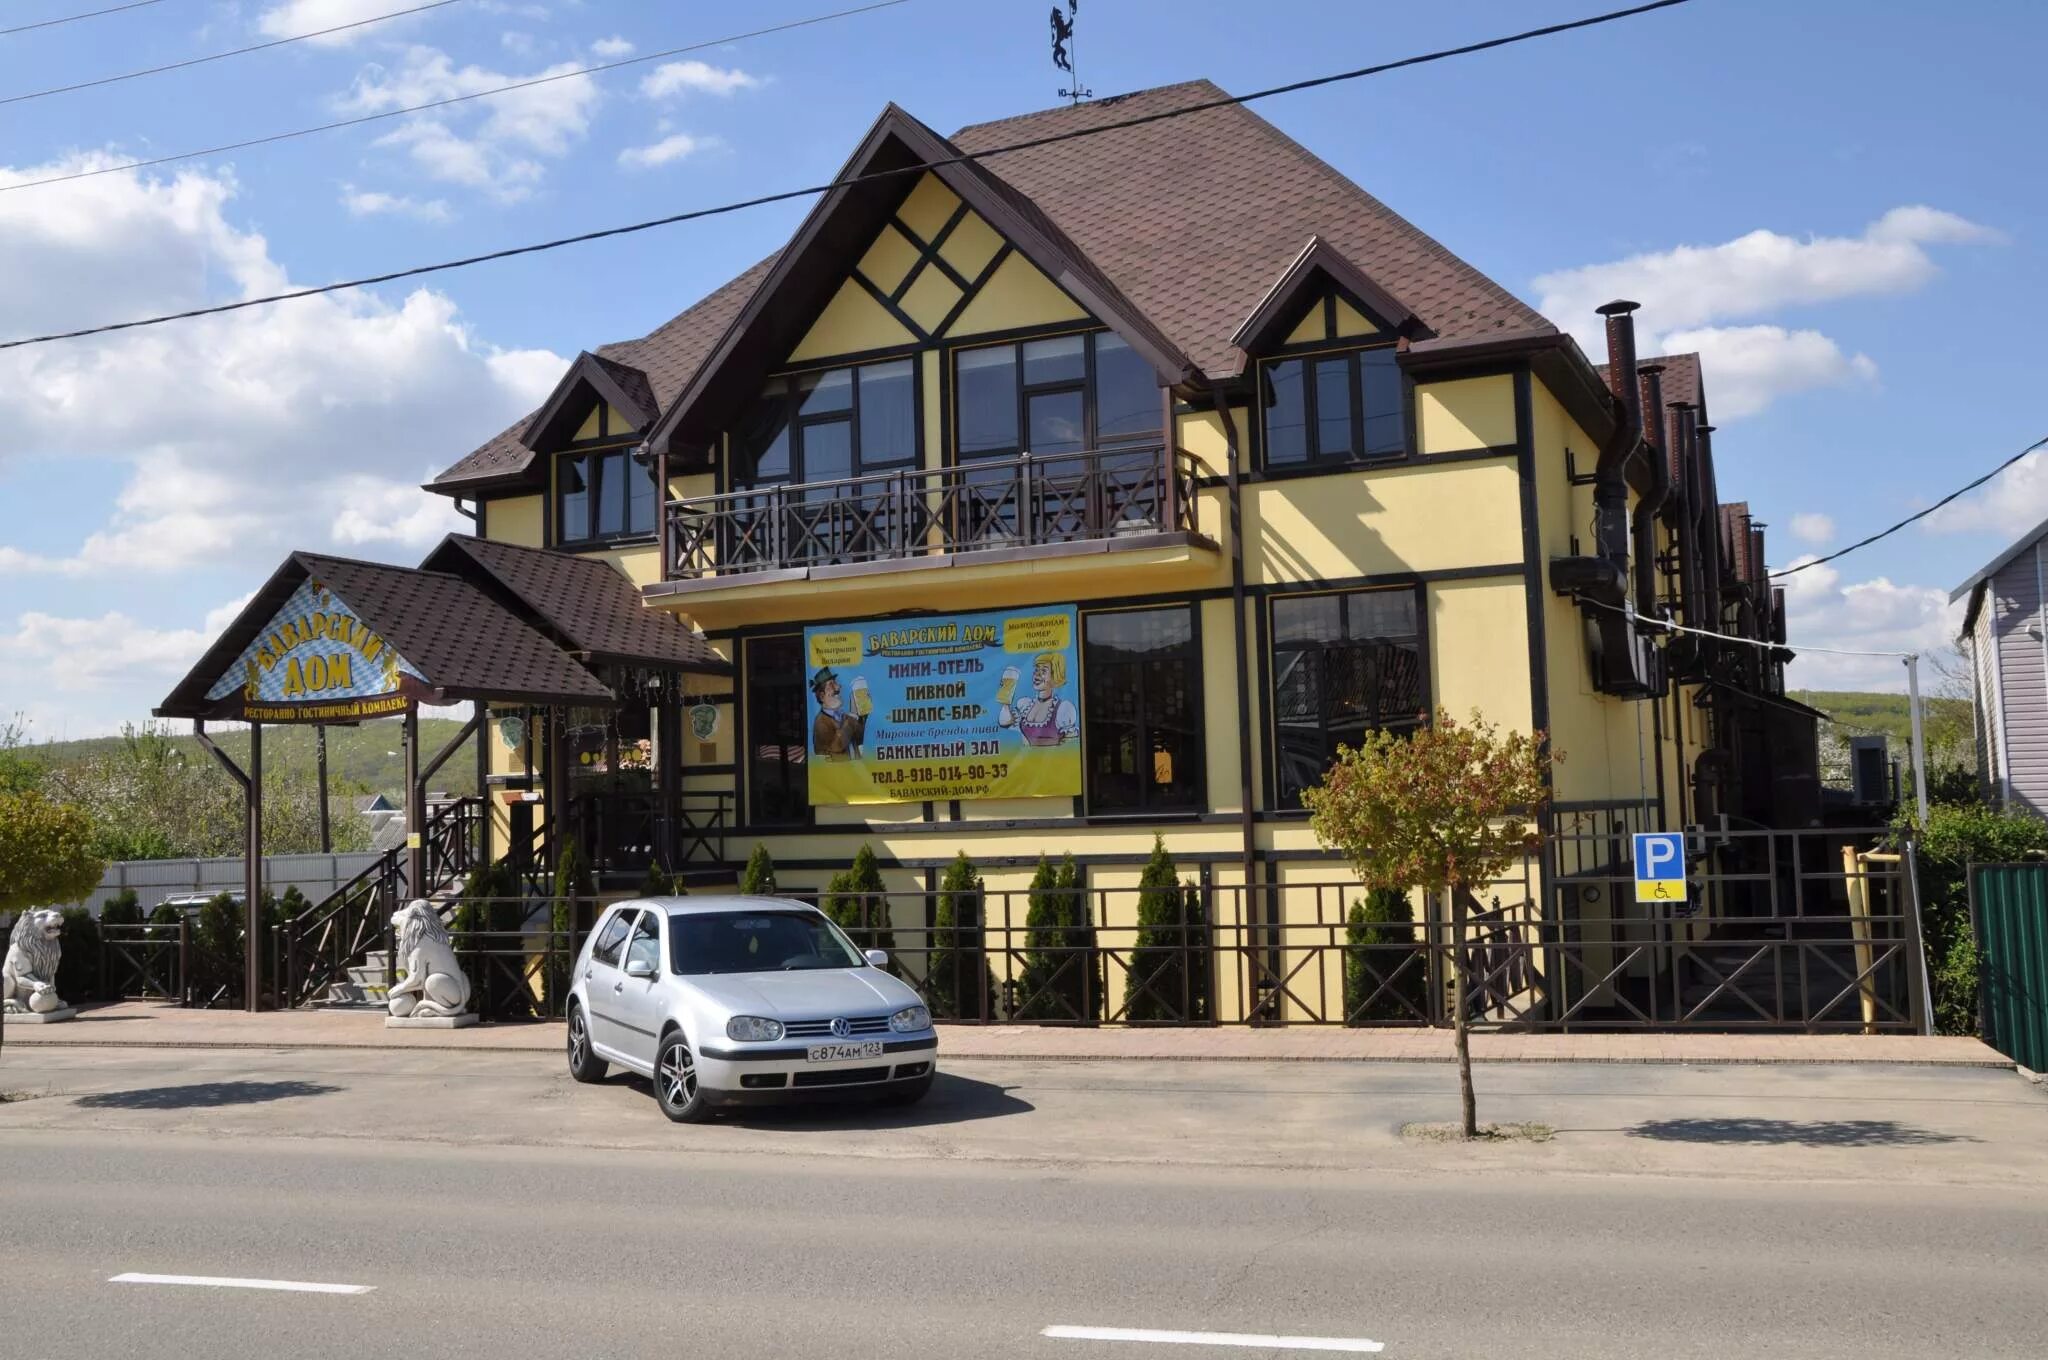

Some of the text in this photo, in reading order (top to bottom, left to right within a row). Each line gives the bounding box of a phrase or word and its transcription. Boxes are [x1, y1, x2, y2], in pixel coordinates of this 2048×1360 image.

[869, 623, 996, 651] БАВАРСКИЙ ДОМ
[283, 653, 353, 697] ДОМ
[888, 658, 984, 679] МИНИ-ОТЕЛЬ
[906, 681, 966, 701] ПИВНОЙ
[244, 696, 408, 720] РЕСТОРАННО ГОСТИНИЧНЫЙ КОМПЛЕКС
[876, 724, 1000, 741] Мировые бренды пива
[877, 740, 1000, 760] БАНКЕТНЫЙ ЗАЛ
[890, 785, 989, 799] БАВАРСКИЙ-ДОМ.РФ
[1646, 837, 1675, 878] P
